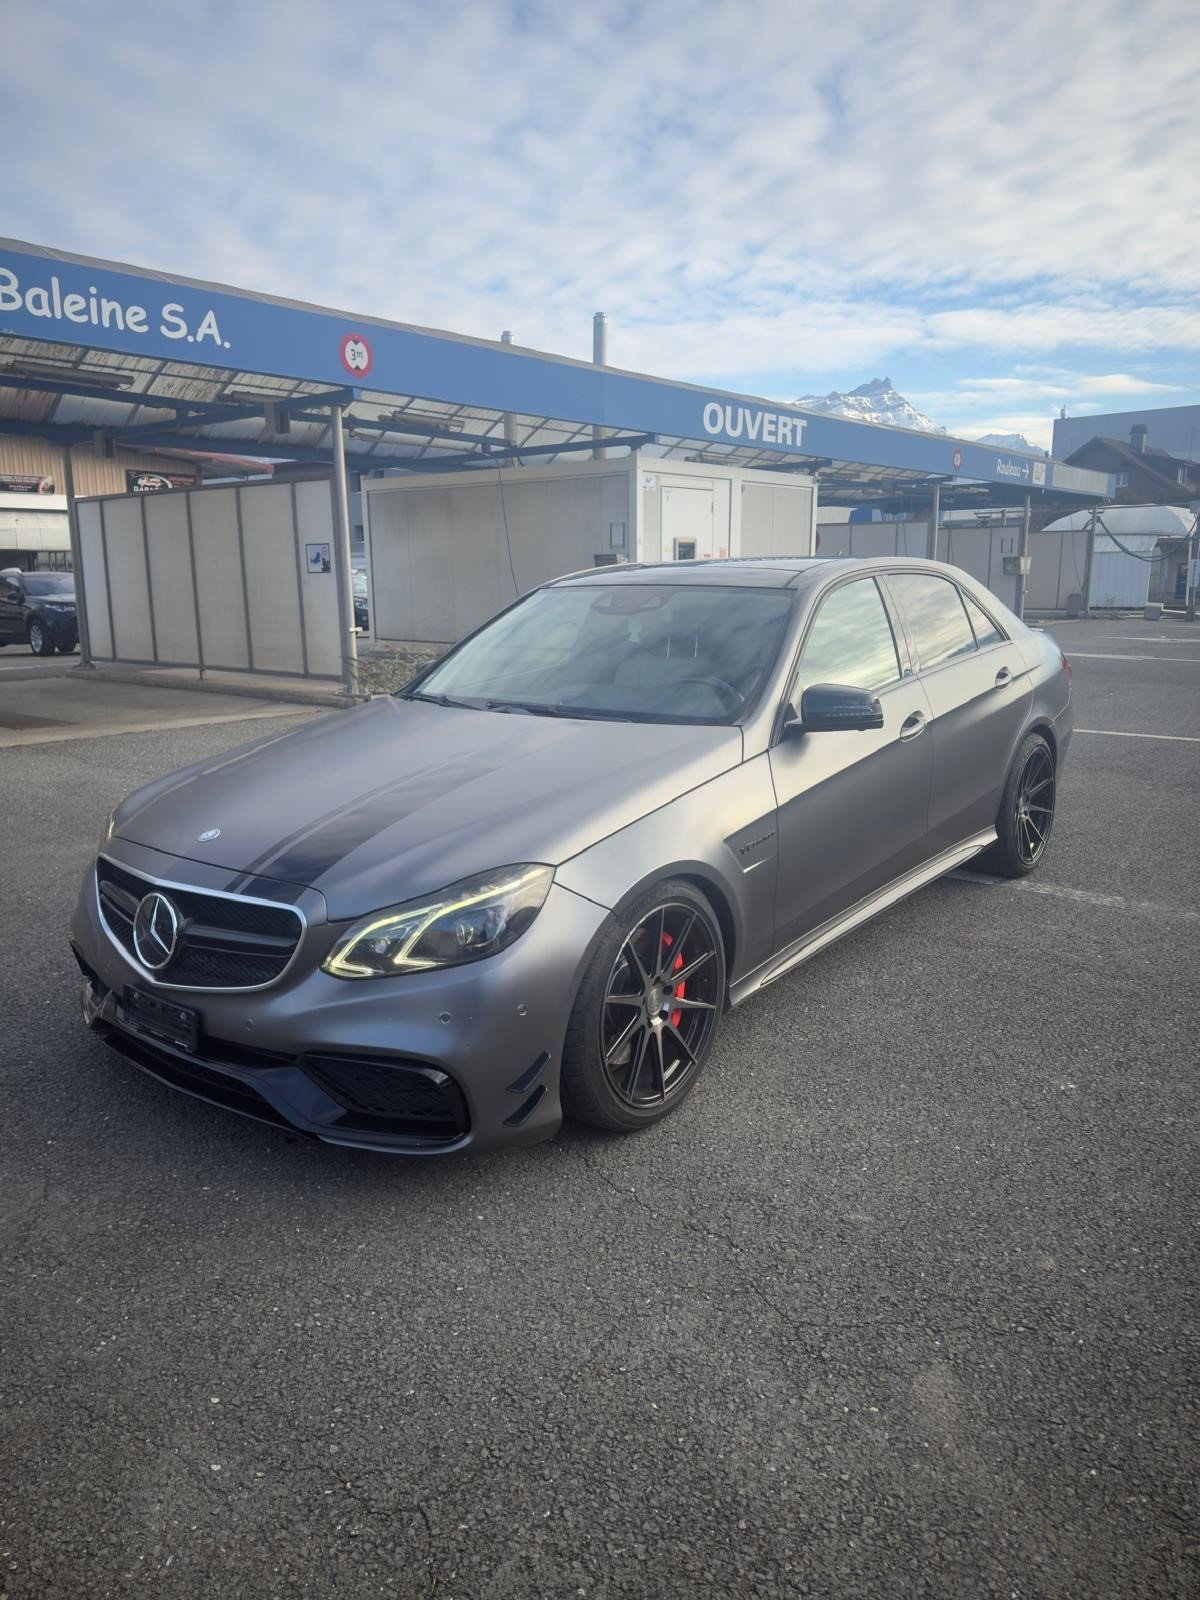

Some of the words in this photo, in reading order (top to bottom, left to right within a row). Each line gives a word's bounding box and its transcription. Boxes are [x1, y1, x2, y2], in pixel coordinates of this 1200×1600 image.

[0, 267, 149, 333] Baleine
[160, 303, 231, 349] S.A.
[703, 402, 807, 447] OUVERT
[996, 458, 1021, 477] Rouleau
